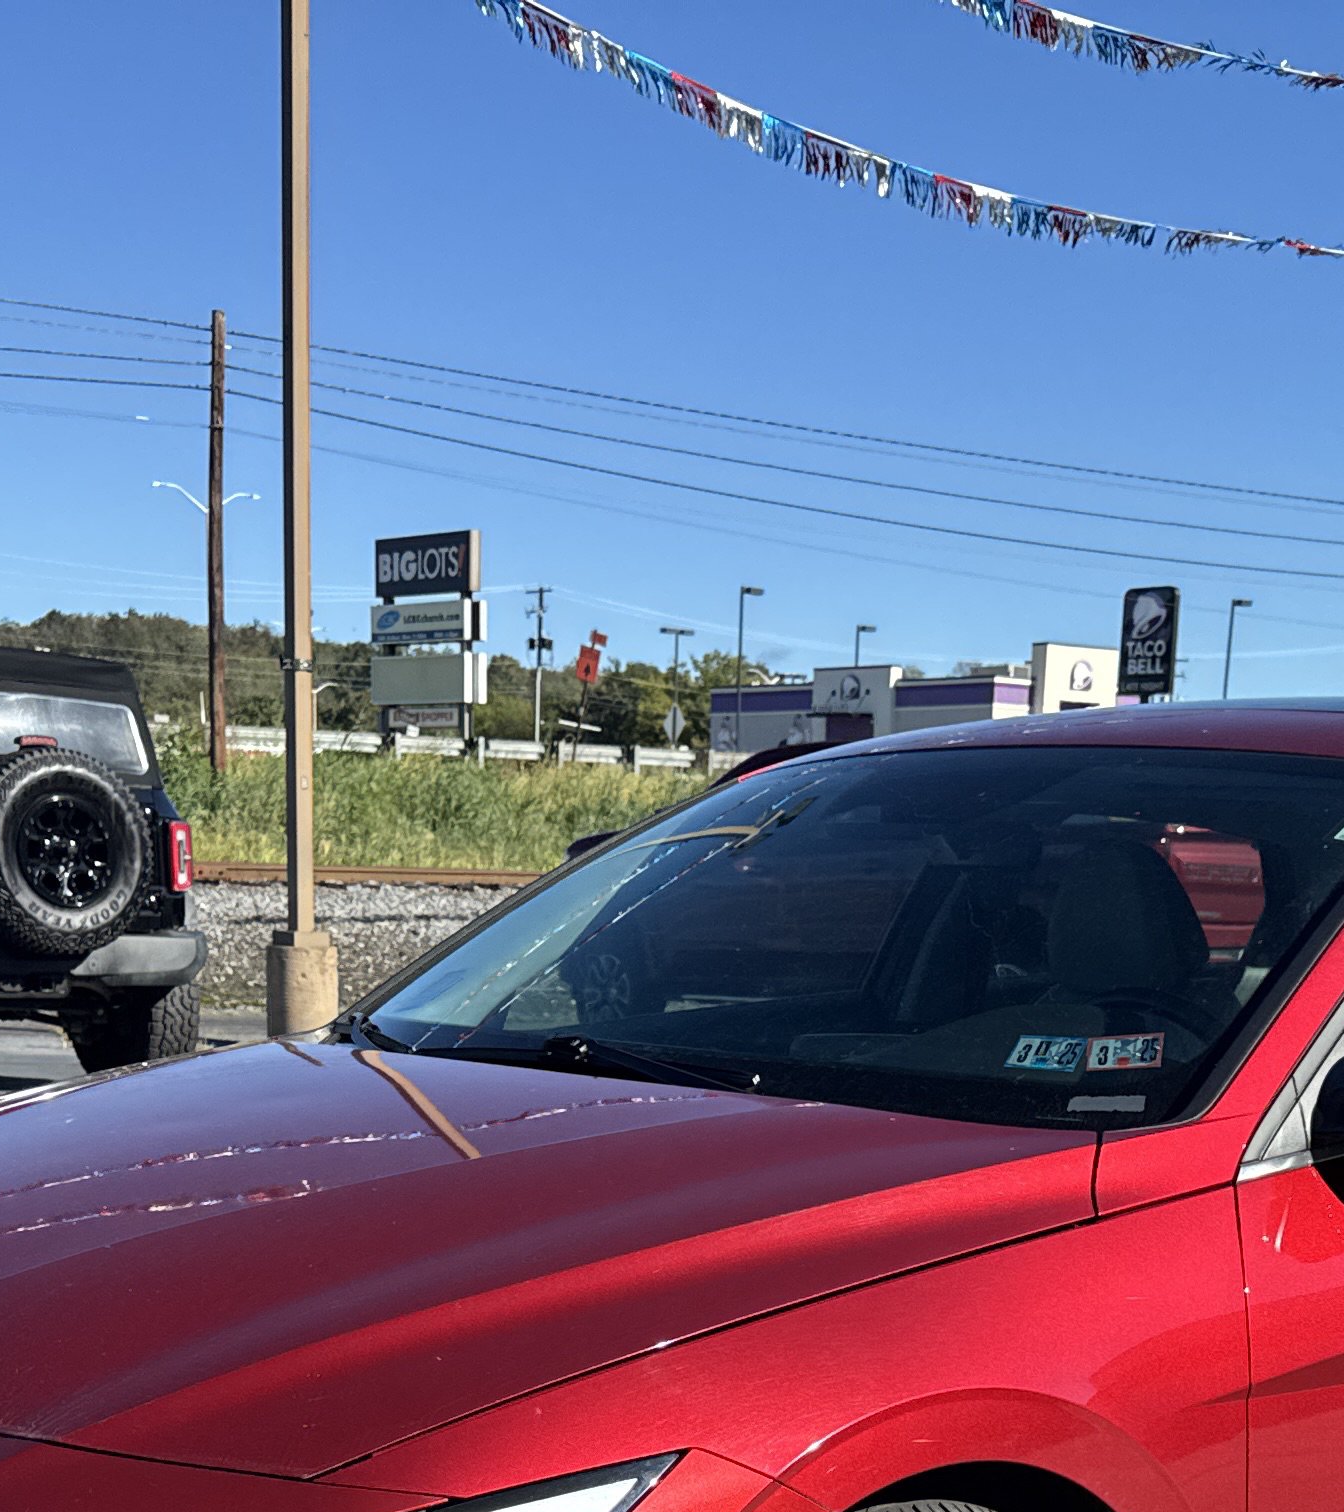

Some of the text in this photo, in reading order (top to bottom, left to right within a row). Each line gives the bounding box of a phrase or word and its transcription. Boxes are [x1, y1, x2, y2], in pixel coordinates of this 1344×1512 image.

[1126, 640, 1167, 657] TACO
[1127, 658, 1164, 675] BELL
[1017, 1044, 1032, 1063] 3
[1057, 1042, 1082, 1065] 25
[1098, 1037, 1159, 1065] 3 25
